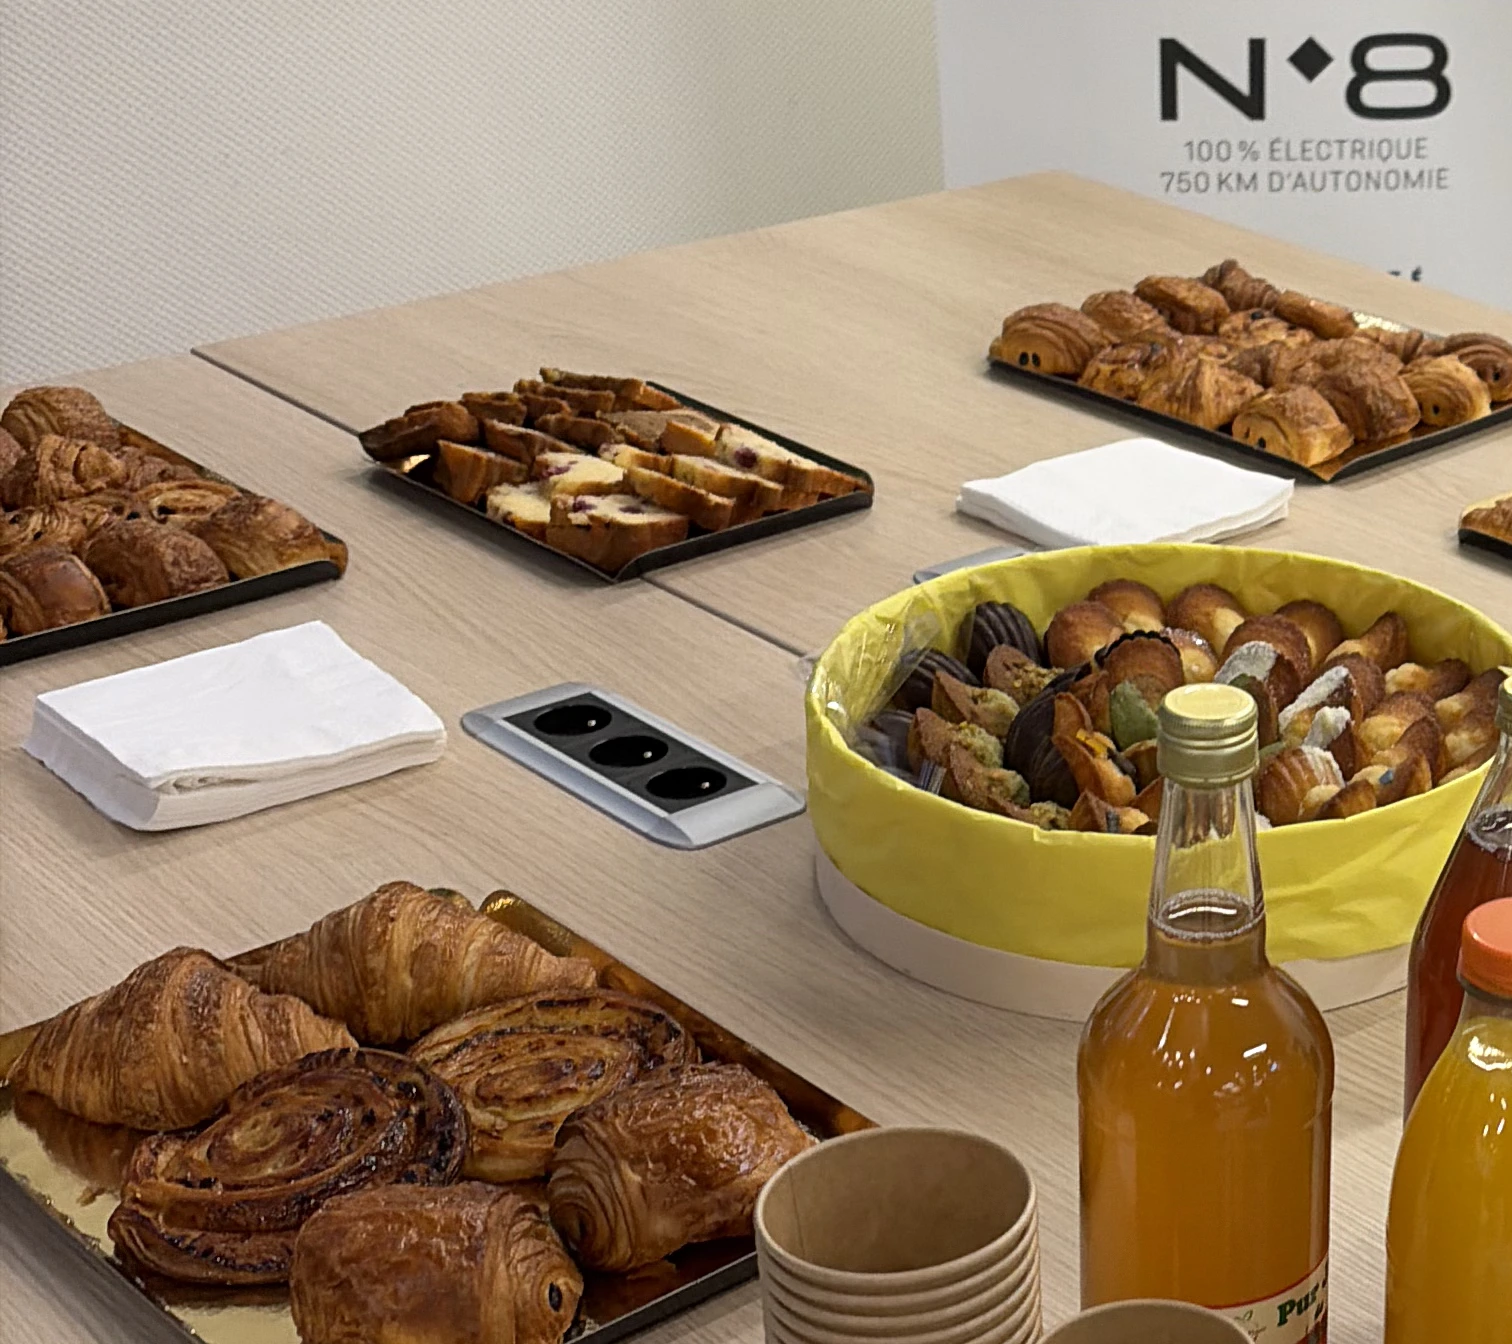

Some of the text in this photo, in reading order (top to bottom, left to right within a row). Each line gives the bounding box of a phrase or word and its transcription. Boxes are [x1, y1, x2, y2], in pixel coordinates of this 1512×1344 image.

[1184, 137, 1428, 162] 100 % ÉLECTRIQUE
[1161, 168, 1450, 194] 750 KM D'AUTONOMIE
[1277, 1282, 1320, 1327] Pur
